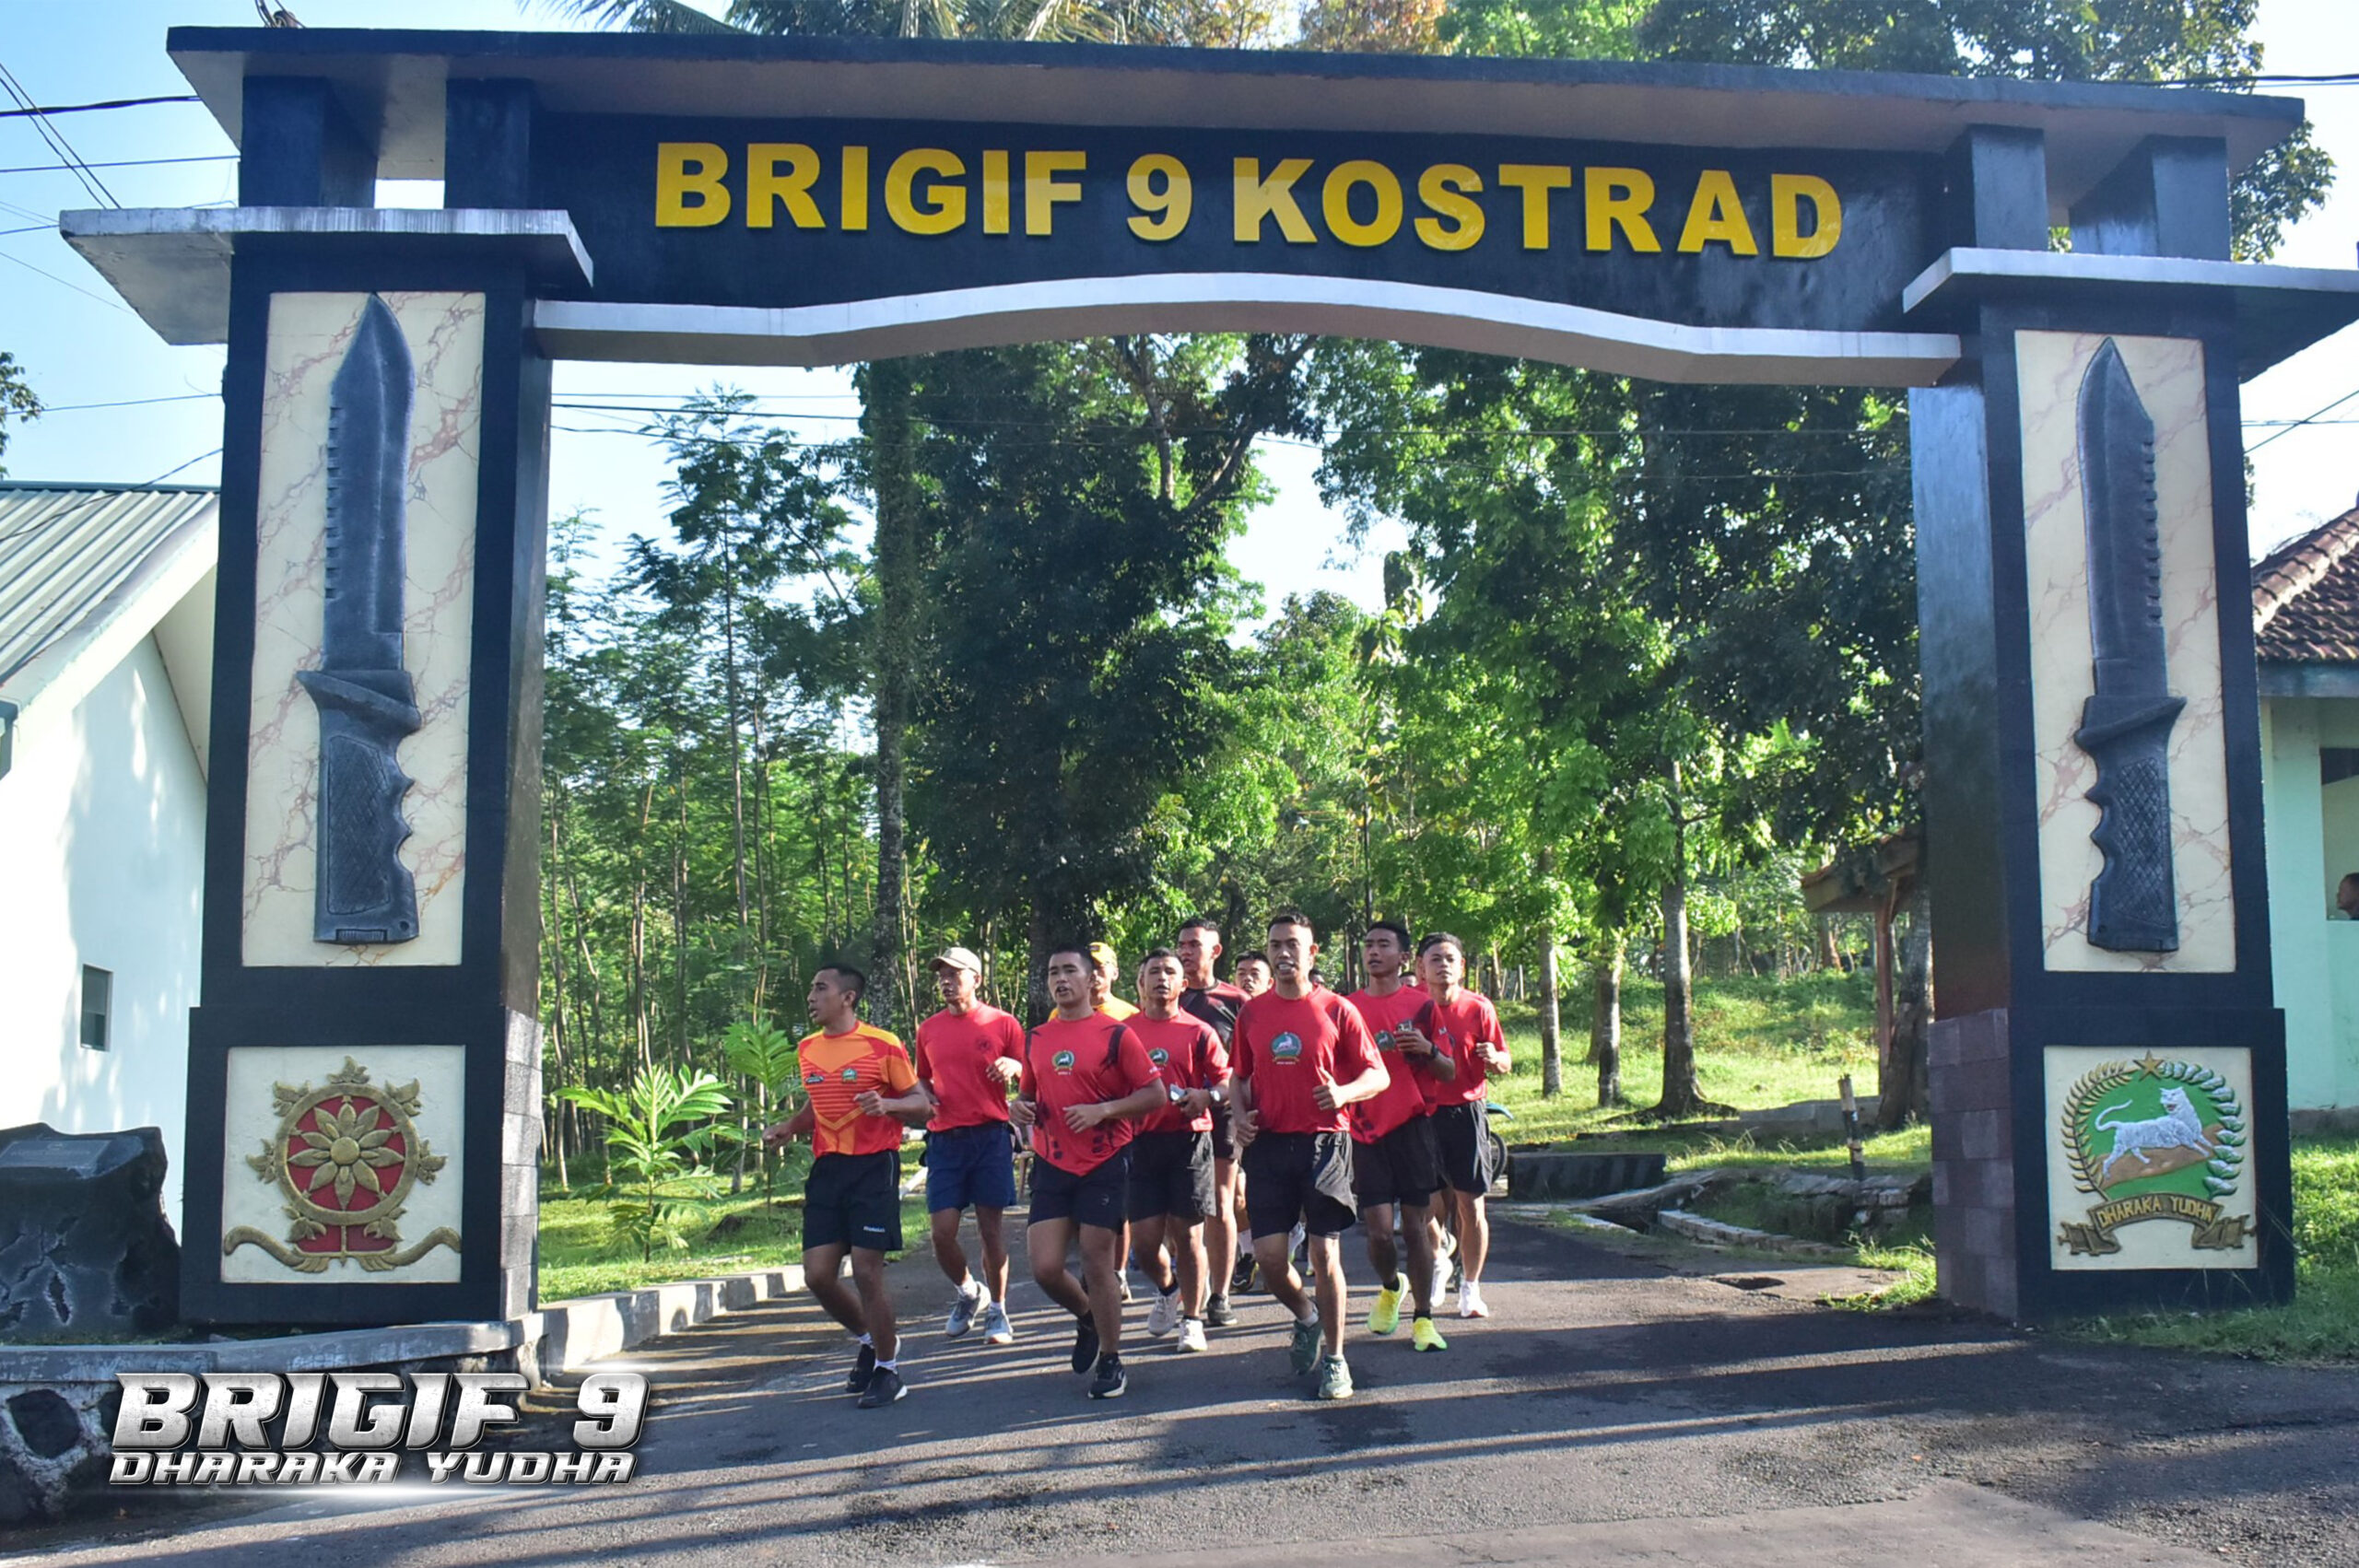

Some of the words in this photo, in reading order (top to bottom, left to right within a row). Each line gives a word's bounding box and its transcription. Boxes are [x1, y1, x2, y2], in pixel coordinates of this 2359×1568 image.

[654, 141, 1087, 237] BRIGIF
[1125, 153, 1194, 241] 9
[1232, 157, 1844, 259] KOSTRAD
[2097, 1196, 2162, 1227] DHARAKA
[2170, 1197, 2213, 1222] YUDHA
